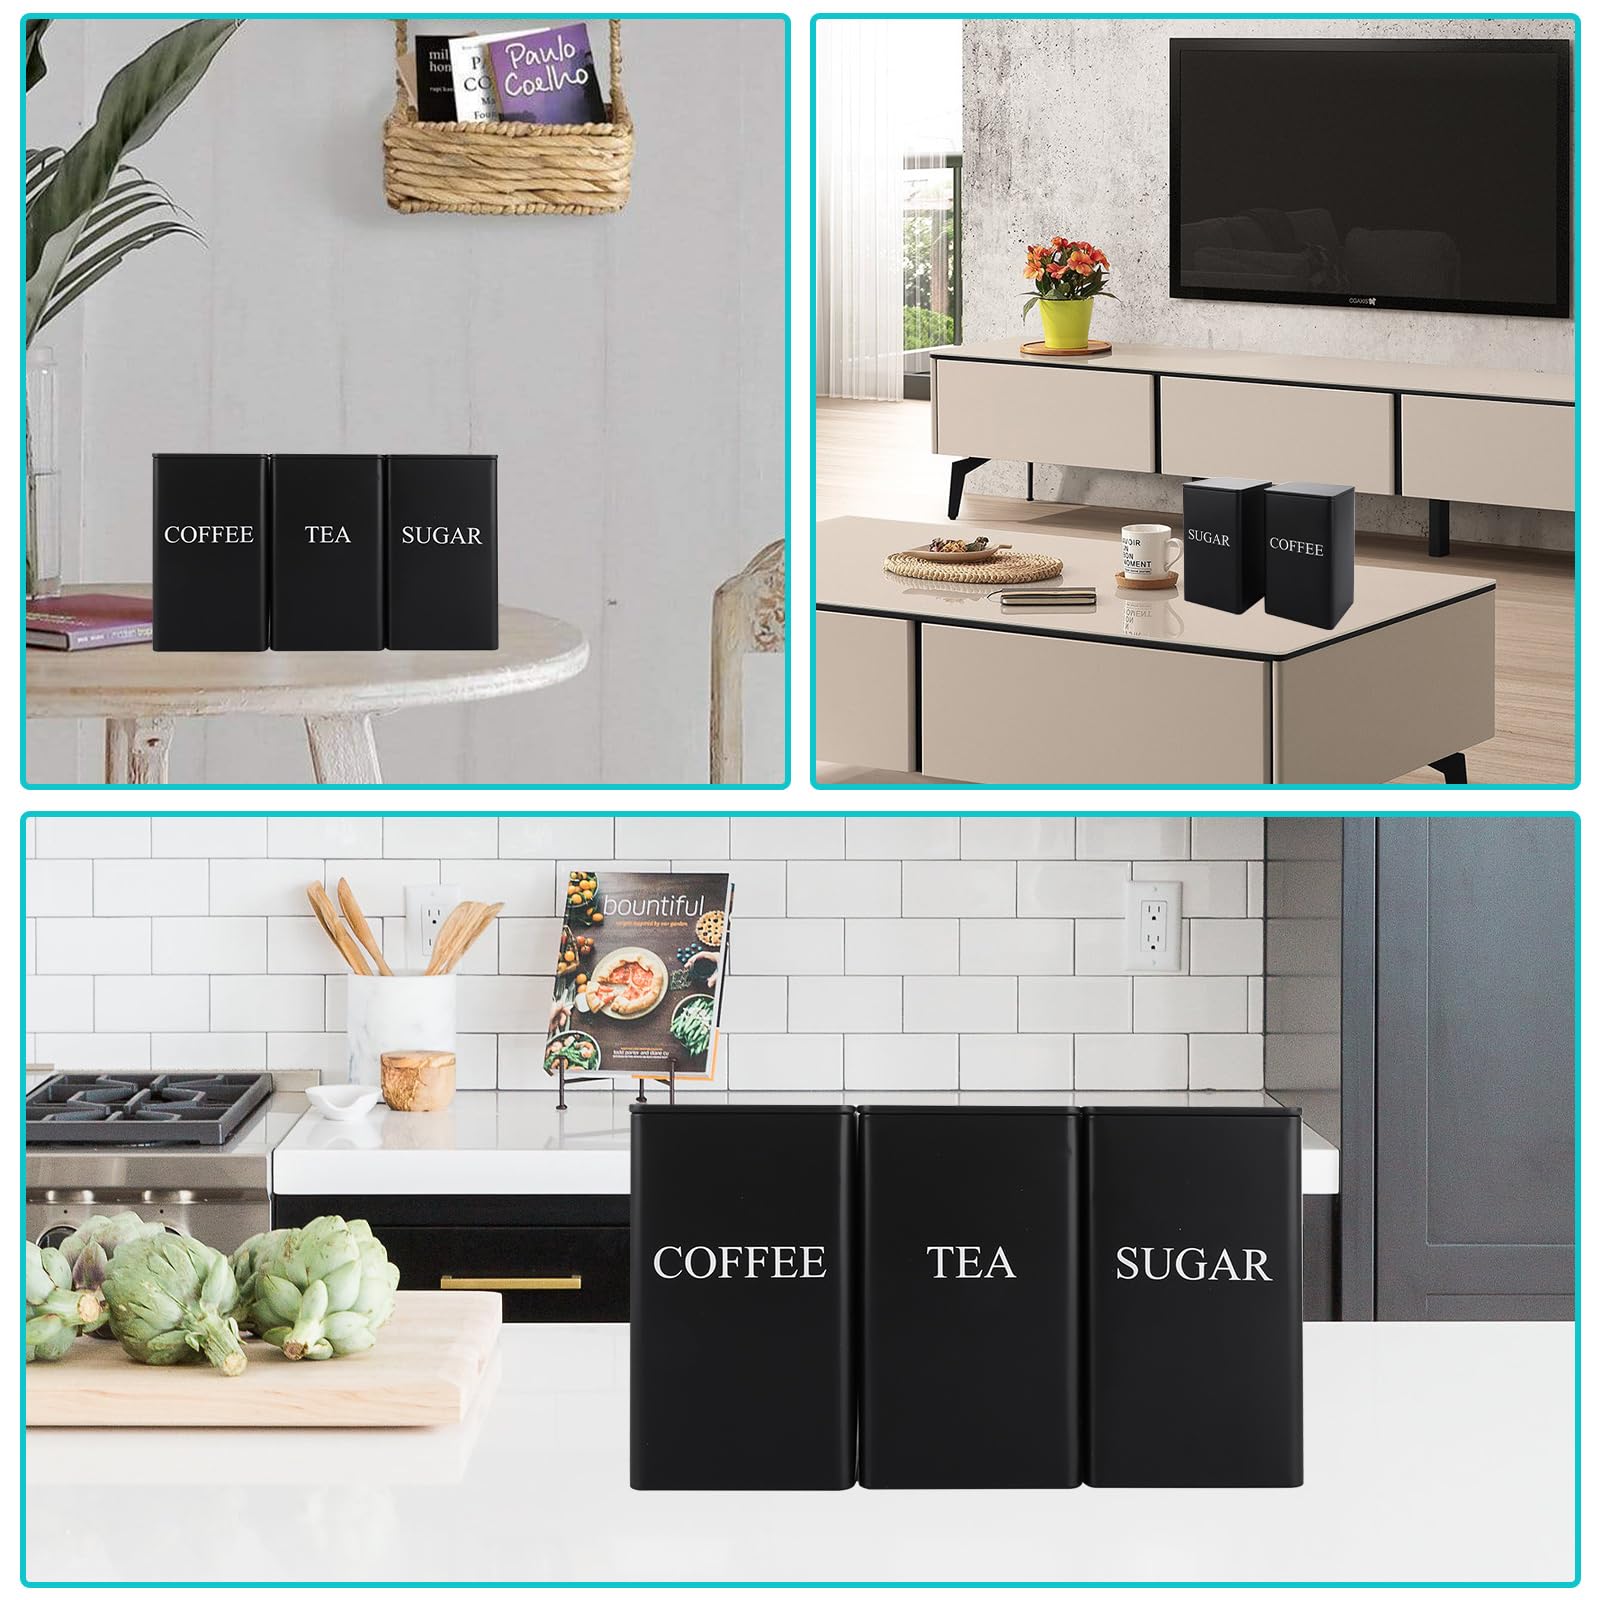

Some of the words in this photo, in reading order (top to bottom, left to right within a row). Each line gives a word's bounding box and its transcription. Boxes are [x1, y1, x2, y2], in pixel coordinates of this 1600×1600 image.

[505, 35, 576, 69] Paulo
[504, 66, 589, 96] Coelho
[164, 525, 254, 544] COFFEE
[304, 525, 352, 544] TEA
[402, 525, 484, 545] SUGAR
[1188, 528, 1231, 548] SUGAR
[1269, 536, 1324, 558] COFFEE
[603, 895, 705, 916] bountiful
[653, 1245, 827, 1279] COFFEE
[926, 1245, 1017, 1279] TEA
[1116, 1245, 1273, 1283] SUGAR
